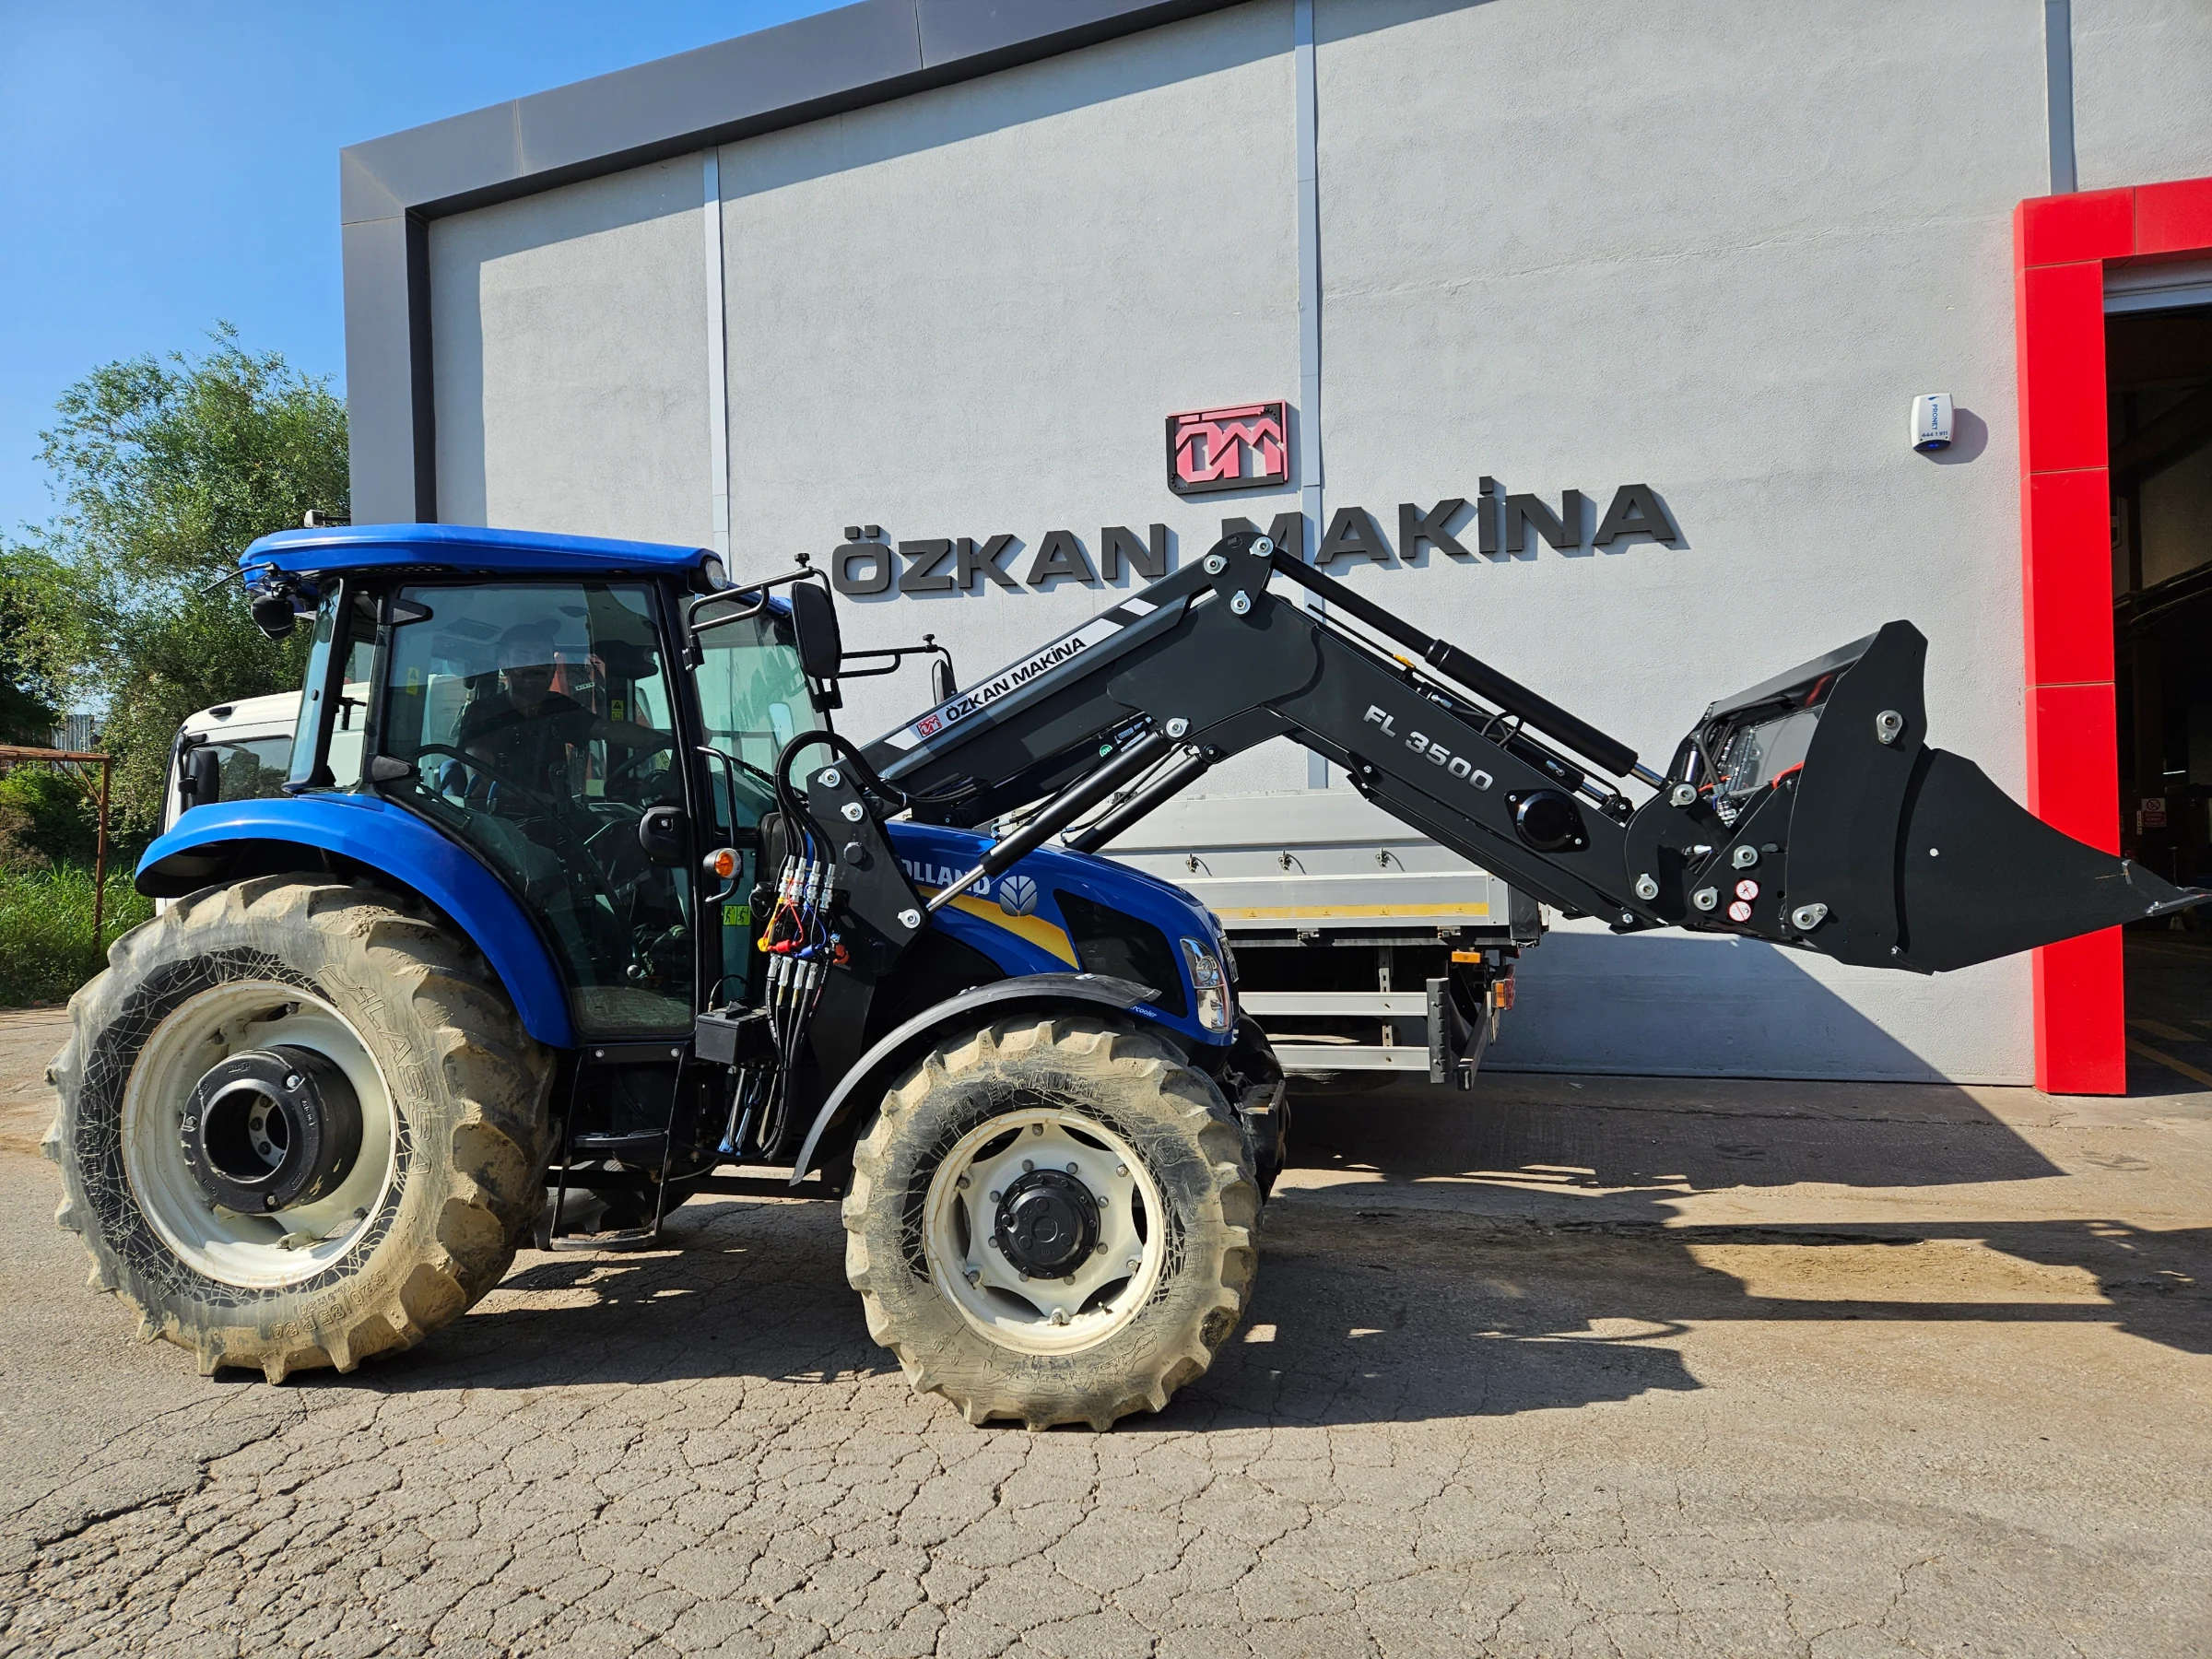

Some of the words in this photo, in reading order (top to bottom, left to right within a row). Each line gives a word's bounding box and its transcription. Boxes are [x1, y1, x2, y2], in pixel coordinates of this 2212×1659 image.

[831, 524, 1168, 594] ÖZKAN
[1221, 476, 1677, 564] MAKİNA
[946, 678, 1011, 722] ÖZKAN
[1011, 637, 1087, 685] MAKİNA
[1362, 704, 1396, 737] FL
[1405, 731, 1494, 792] 3500
[901, 859, 991, 895] OLLAND
[359, 994, 431, 1176] LASSA
